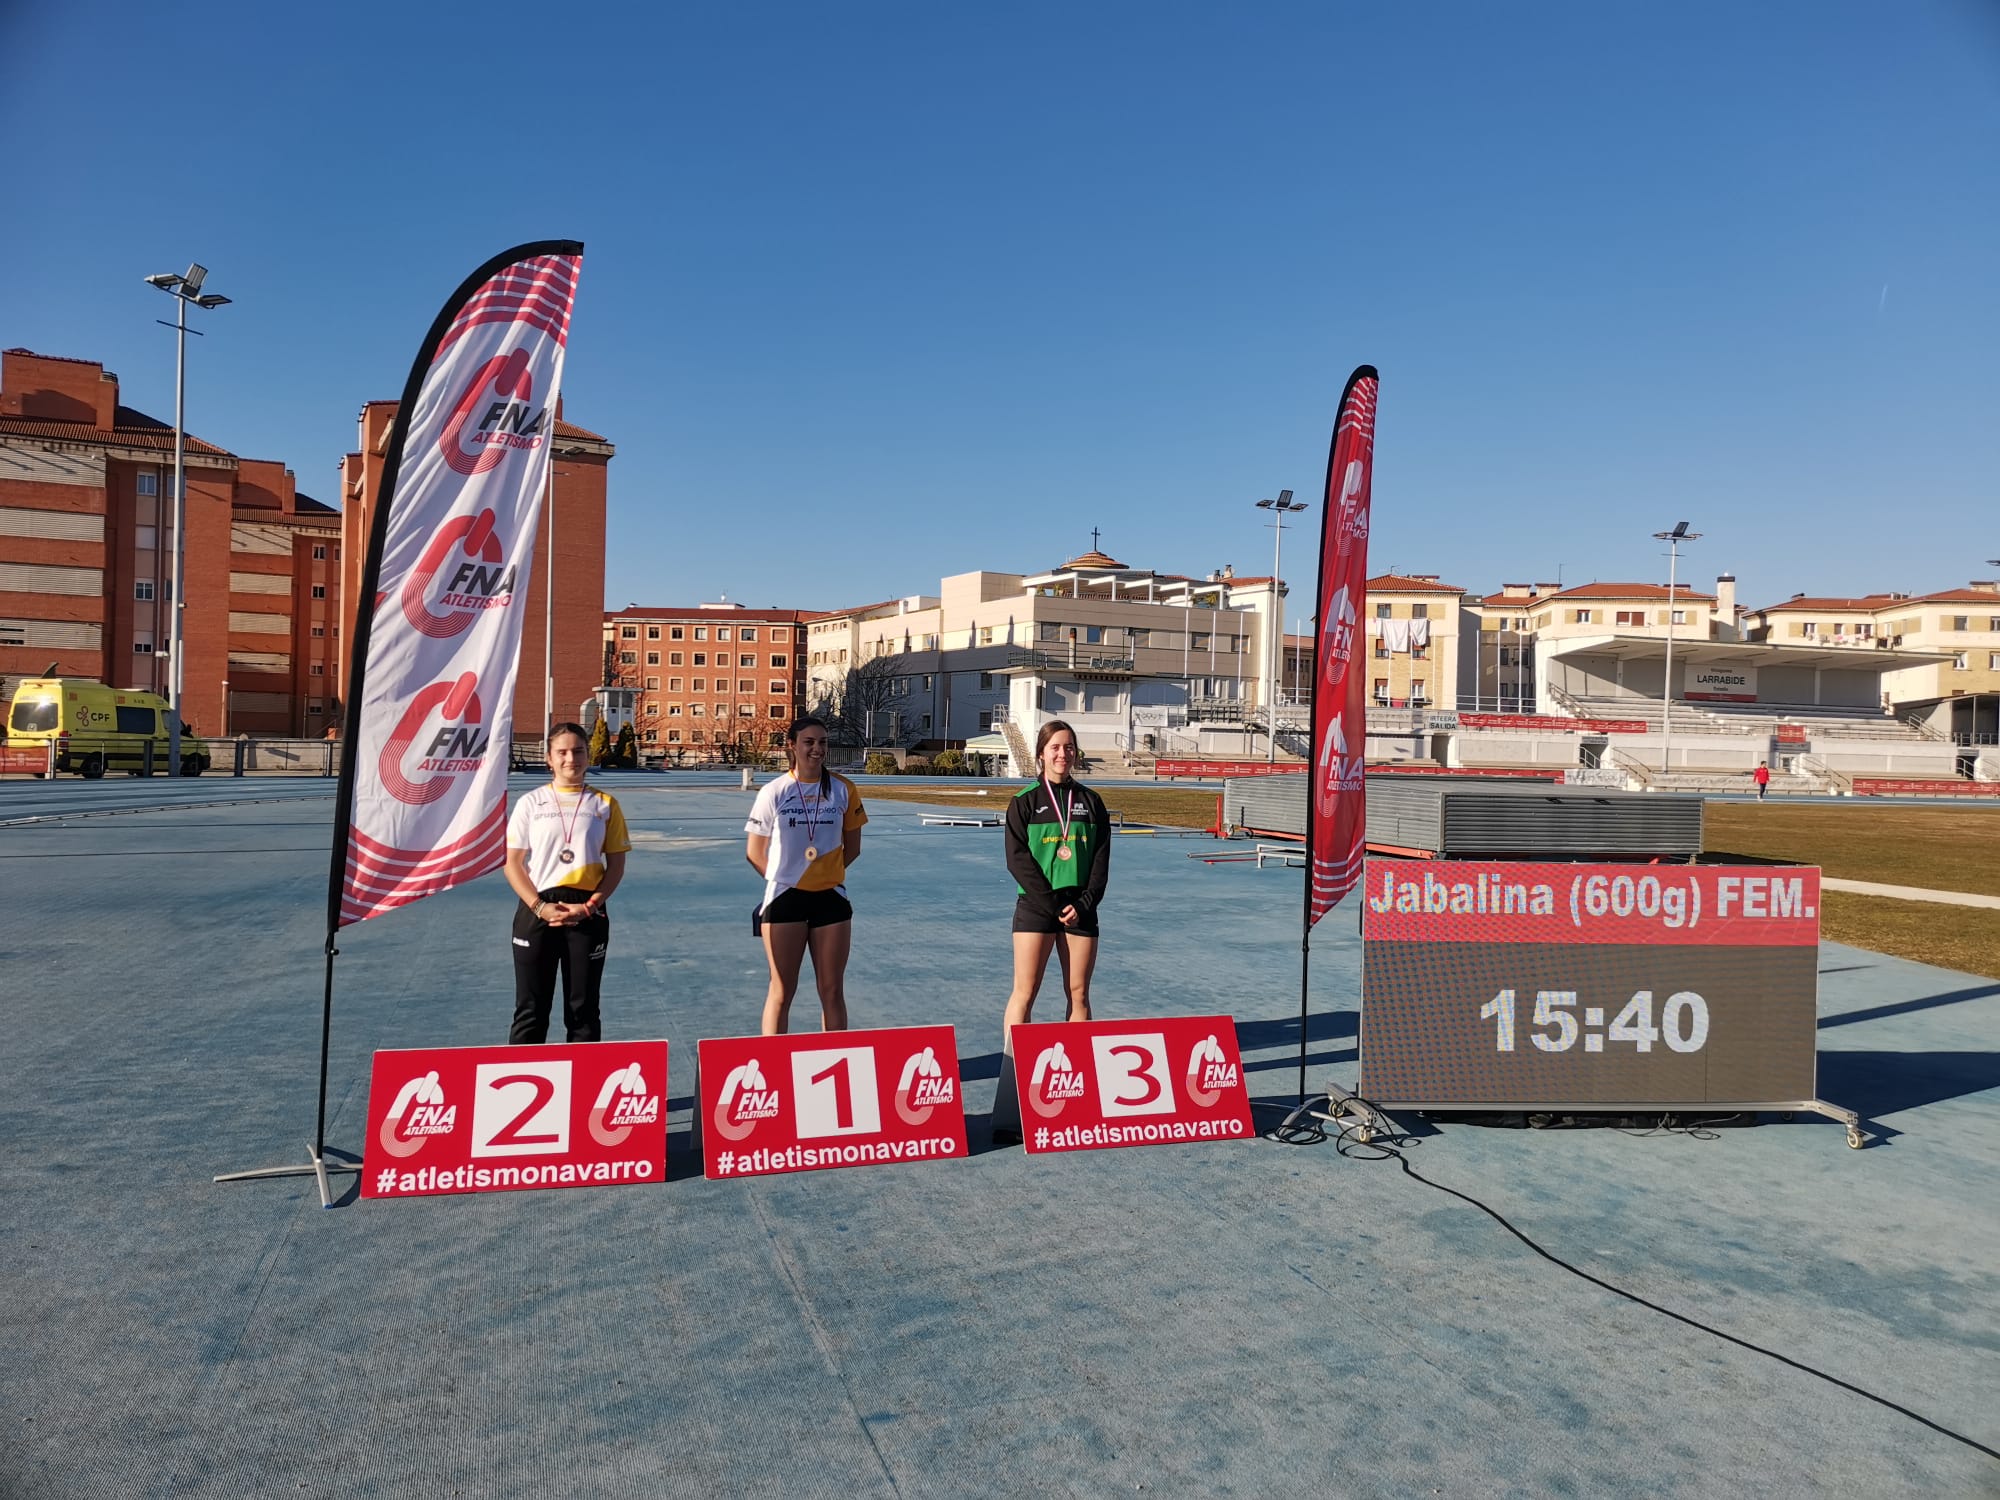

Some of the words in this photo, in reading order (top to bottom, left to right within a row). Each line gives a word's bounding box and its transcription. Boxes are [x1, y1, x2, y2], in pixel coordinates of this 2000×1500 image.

[478, 402, 547, 436] FNA
[471, 431, 542, 450] ATLETISMO
[446, 562, 516, 596] FNA
[439, 592, 512, 609] ATLETISMO
[1697, 674, 1745, 685] LARRABIDE
[91, 712, 110, 722] CPF
[1430, 722, 1457, 730] SALIDA
[1329, 755, 1364, 781] FNA
[1370, 871, 1554, 915] Jabalina
[1570, 874, 1701, 928] (600g)
[1717, 877, 1815, 919] FEM.
[1480, 989, 1709, 1053] 15:40
[1048, 1072, 1085, 1091] FNA
[1109, 1045, 1162, 1106] 3
[1204, 1064, 1237, 1081] FNA
[811, 1057, 853, 1129] 1
[915, 1077, 953, 1097] FNA
[1047, 1089, 1085, 1099] ATLETISMO
[1203, 1079, 1238, 1089] ATLETISMO
[613, 1096, 659, 1116] FNA
[737, 1090, 779, 1111] FNA
[913, 1095, 954, 1105] ATLETISMO
[408, 1105, 457, 1126] FNA
[485, 1074, 559, 1147] 2
[609, 1114, 657, 1125] ATLETISMO
[735, 1109, 778, 1120] ATLETISMO
[403, 1125, 454, 1136] ATLETISMO
[1034, 1118, 1243, 1149] #atletismonavarro
[717, 1137, 956, 1175] #atletismonavarro
[377, 1160, 652, 1193] #atletismonavarro
